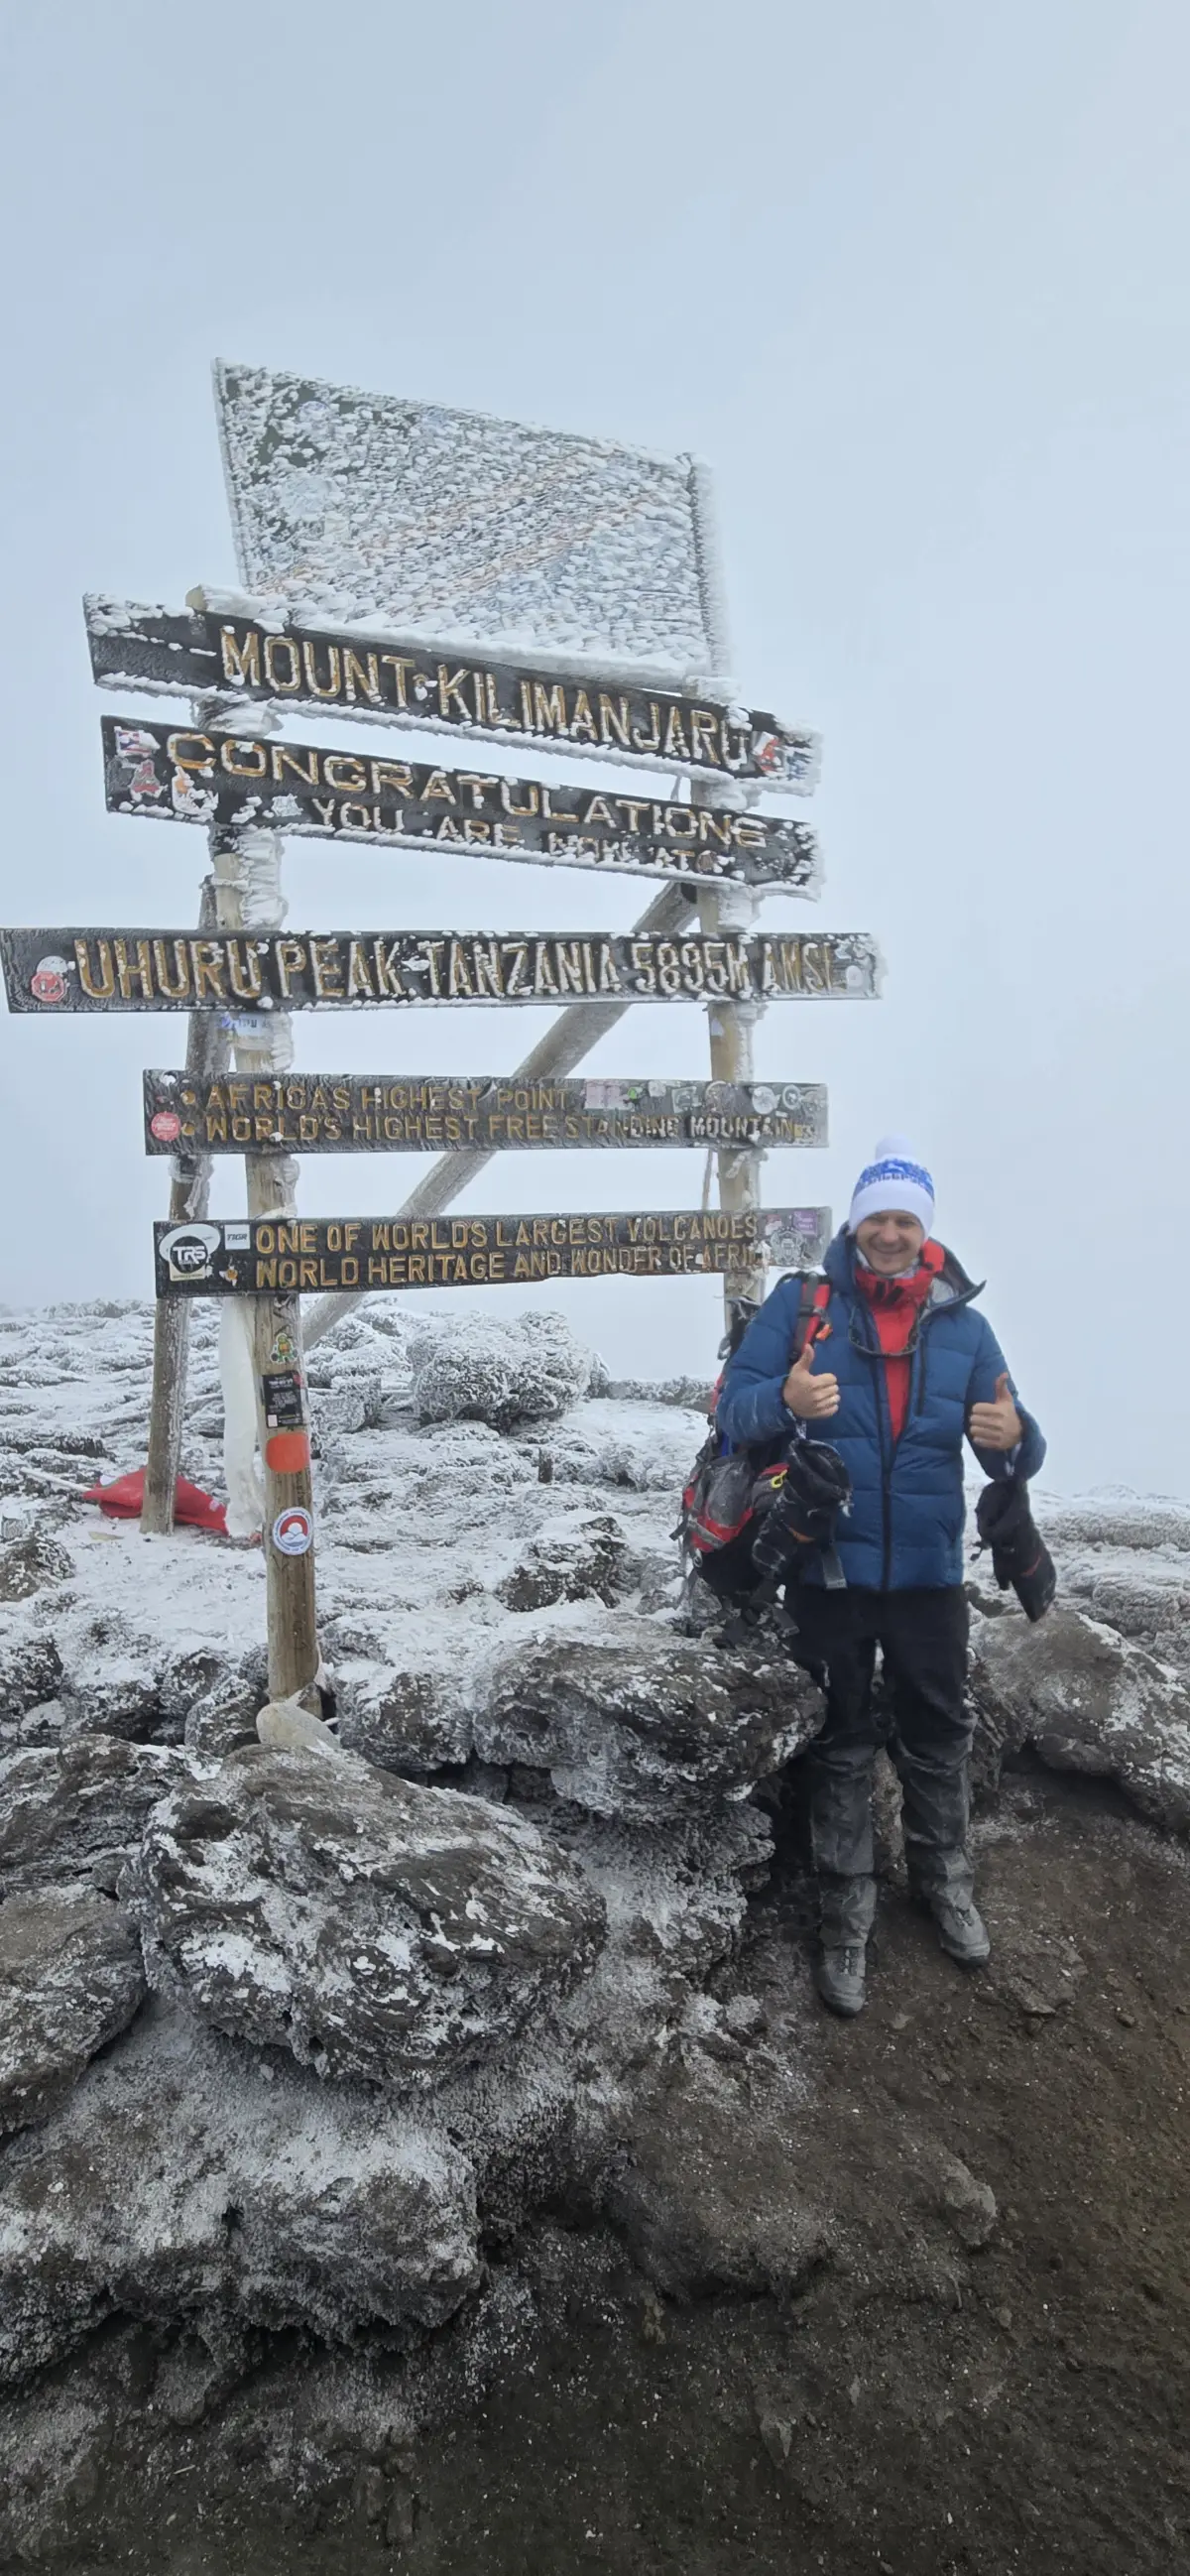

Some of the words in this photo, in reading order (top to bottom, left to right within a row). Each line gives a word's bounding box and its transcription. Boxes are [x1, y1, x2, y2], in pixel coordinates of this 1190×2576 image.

[220, 626, 416, 707] MOUNT
[166, 732, 769, 848] CONGRATULATIONS
[311, 797, 405, 834] YOU
[436, 816, 524, 848] ARE
[74, 938, 263, 998] UHURU
[275, 939, 404, 998] PEAK
[417, 940, 620, 995] TANZANIA
[631, 940, 751, 995] 5895M
[362, 1086, 480, 1110] HIGHEST
[496, 1087, 568, 1111] POINT
[352, 1115, 480, 1141] HIGHEST
[489, 1115, 557, 1140] FREE
[173, 1245, 206, 1265] TRS
[256, 1222, 317, 1254] ONE
[327, 1222, 361, 1252] OF
[497, 1216, 619, 1247] LARGEST
[627, 1213, 758, 1242] VOLCANOES
[256, 1257, 360, 1288] WORLD
[368, 1251, 506, 1285] HERITAGE
[514, 1249, 561, 1278] AND
[571, 1245, 662, 1275] WONDER
[669, 1244, 700, 1274] OF
